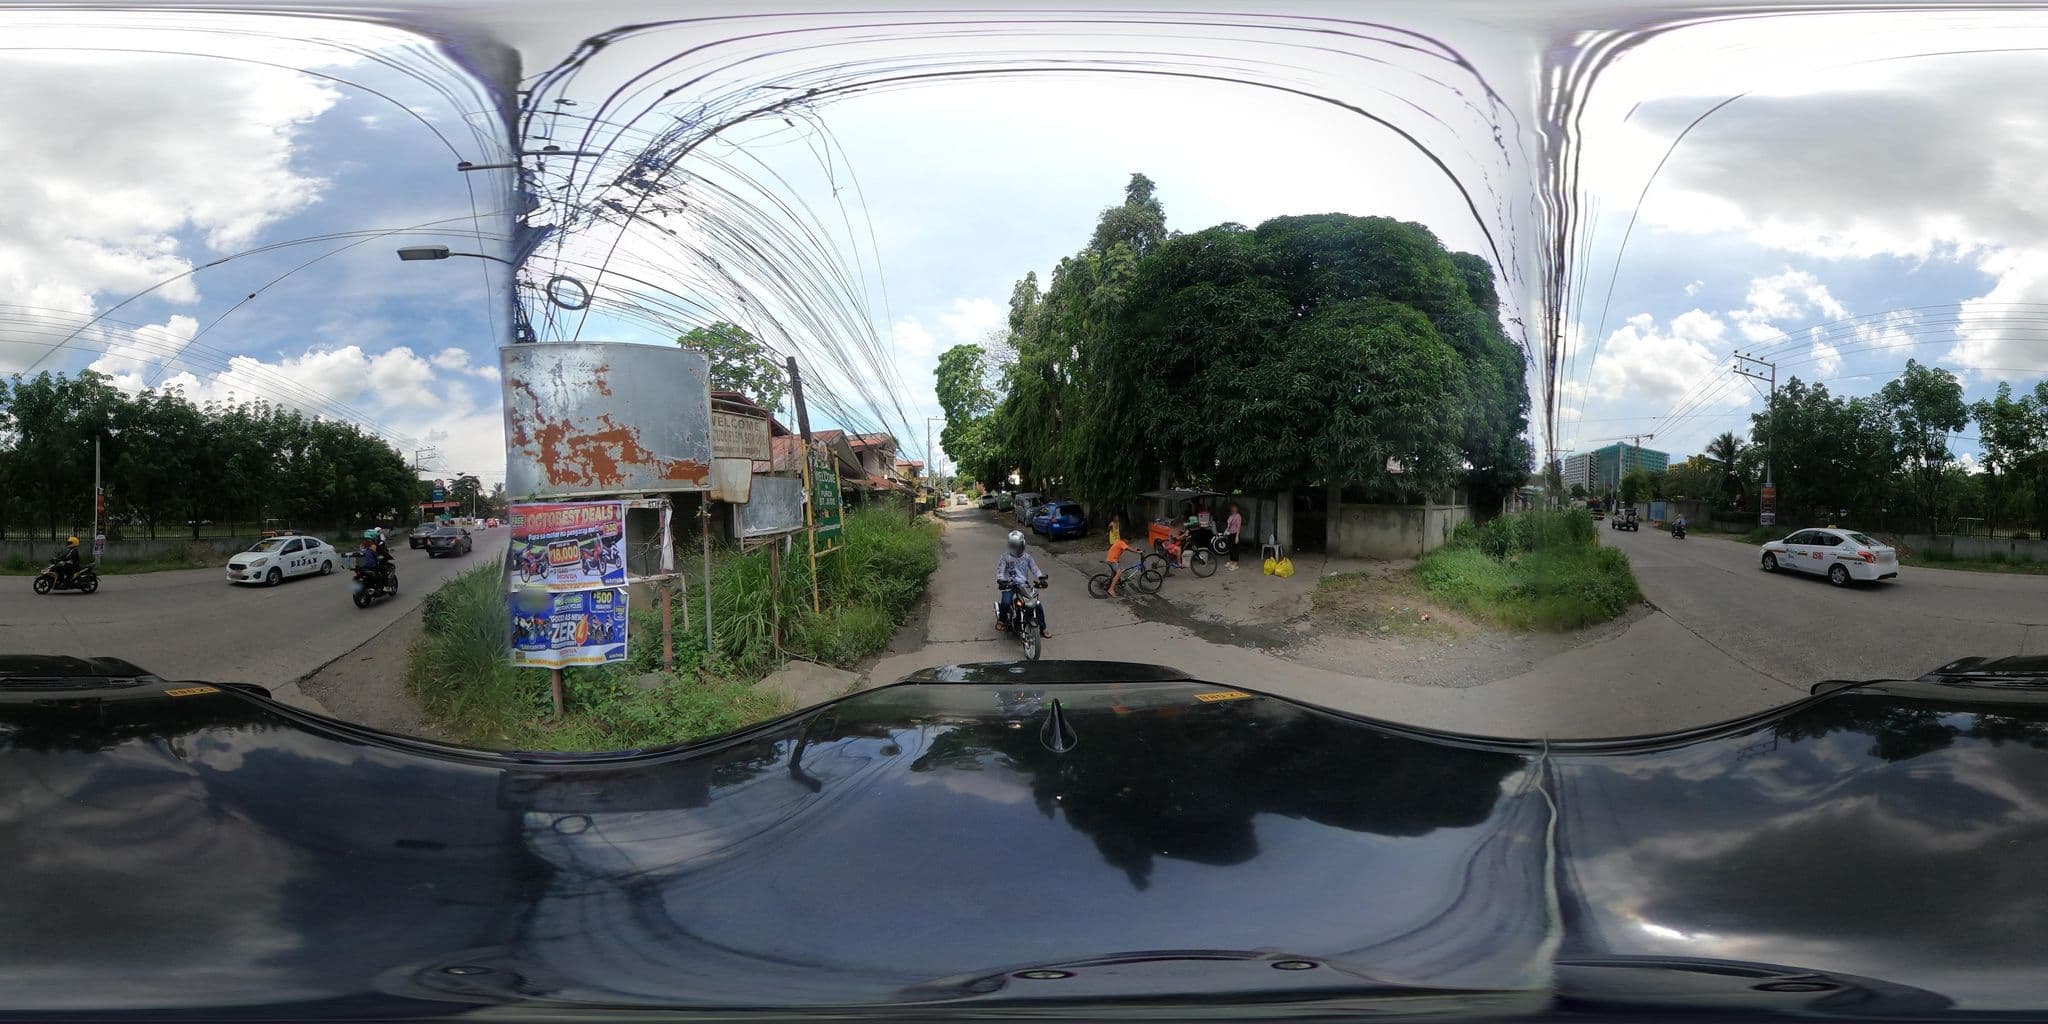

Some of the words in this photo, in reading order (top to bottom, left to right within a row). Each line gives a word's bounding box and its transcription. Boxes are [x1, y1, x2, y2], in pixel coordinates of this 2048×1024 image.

[814, 471, 836, 484] WELCOME
[582, 505, 614, 525] DEALS
[289, 558, 317, 567] BIJAN
